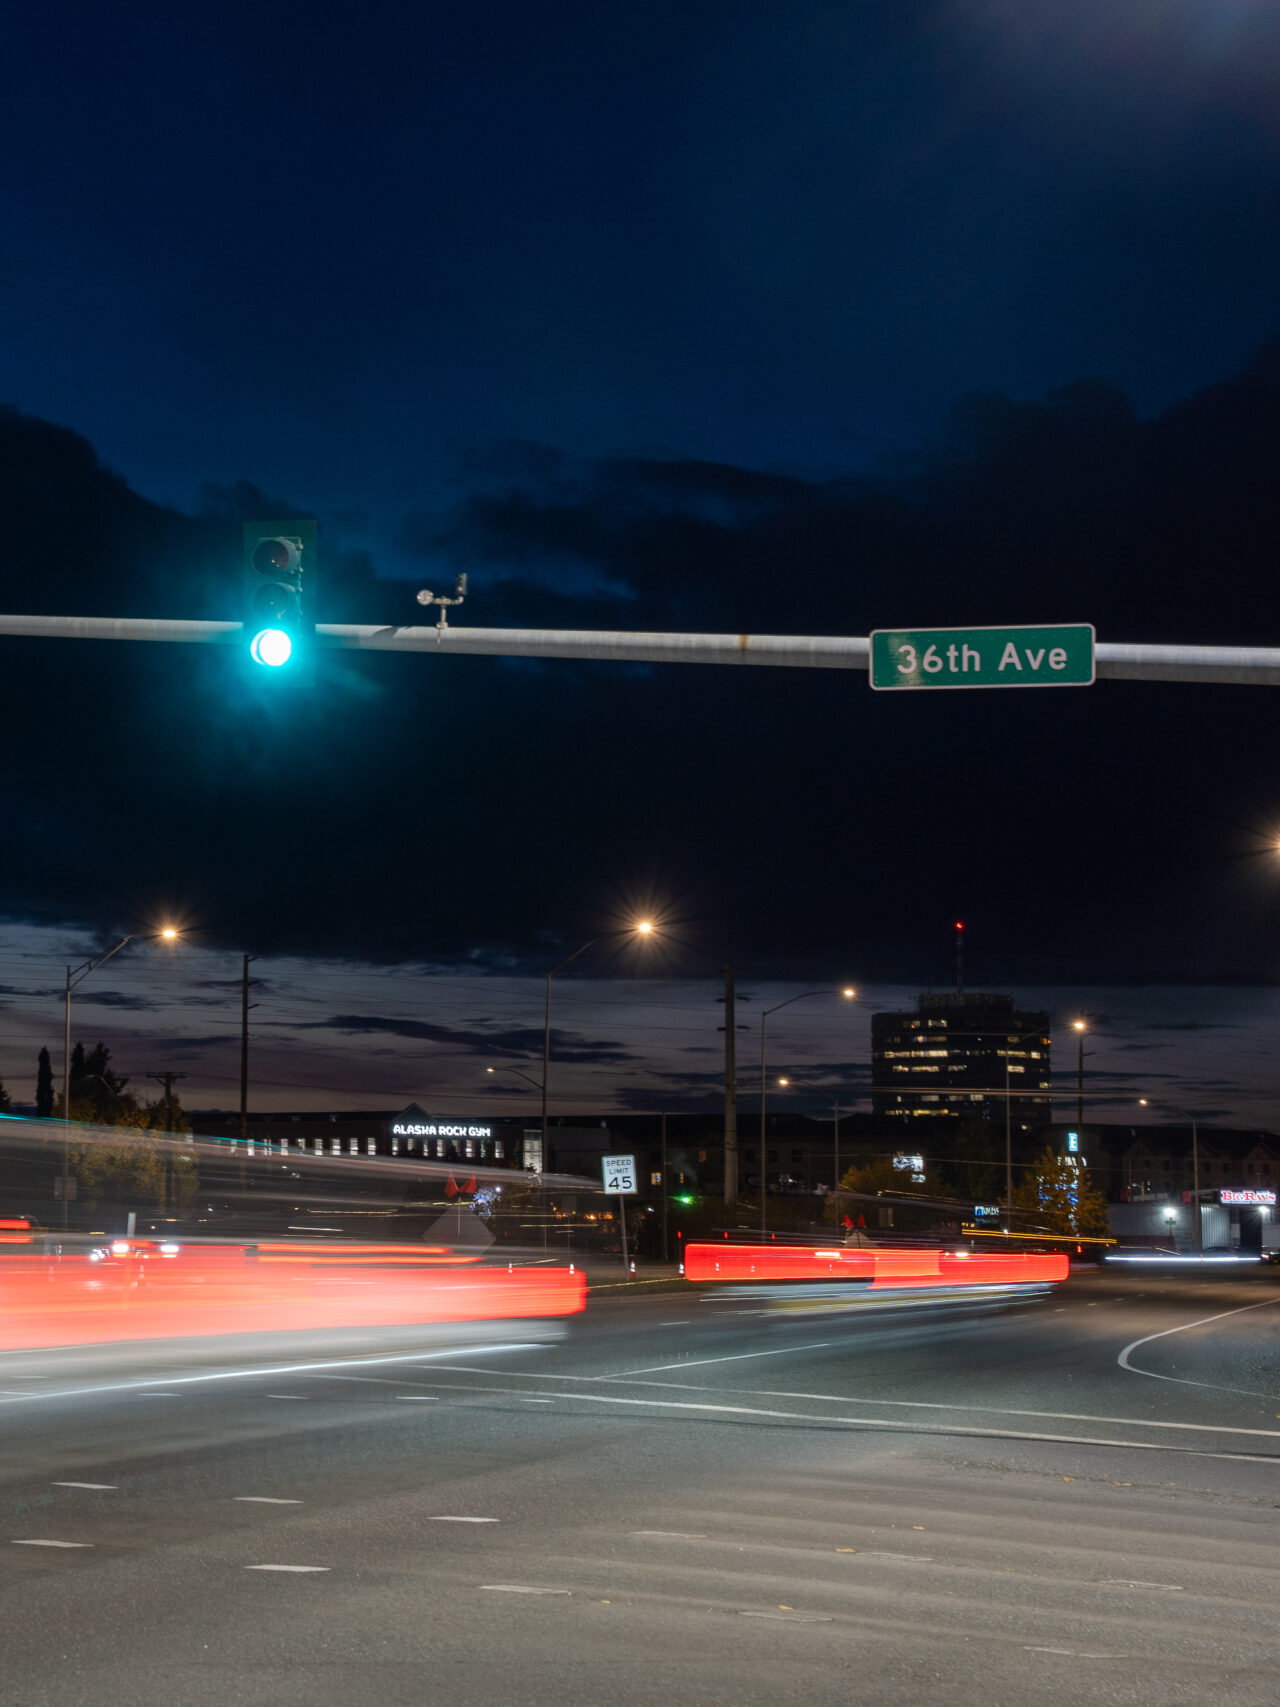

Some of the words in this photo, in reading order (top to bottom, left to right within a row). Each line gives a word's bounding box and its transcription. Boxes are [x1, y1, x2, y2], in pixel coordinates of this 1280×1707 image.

[897, 643, 981, 674] 36th
[997, 641, 1068, 672] Ave
[392, 1123, 437, 1135] ALASKA
[438, 1125, 467, 1137] ROCK
[468, 1126, 491, 1137] GYM
[606, 1159, 632, 1167] SPEED
[609, 1167, 629, 1175] LIMIT
[608, 1175, 632, 1190] 45
